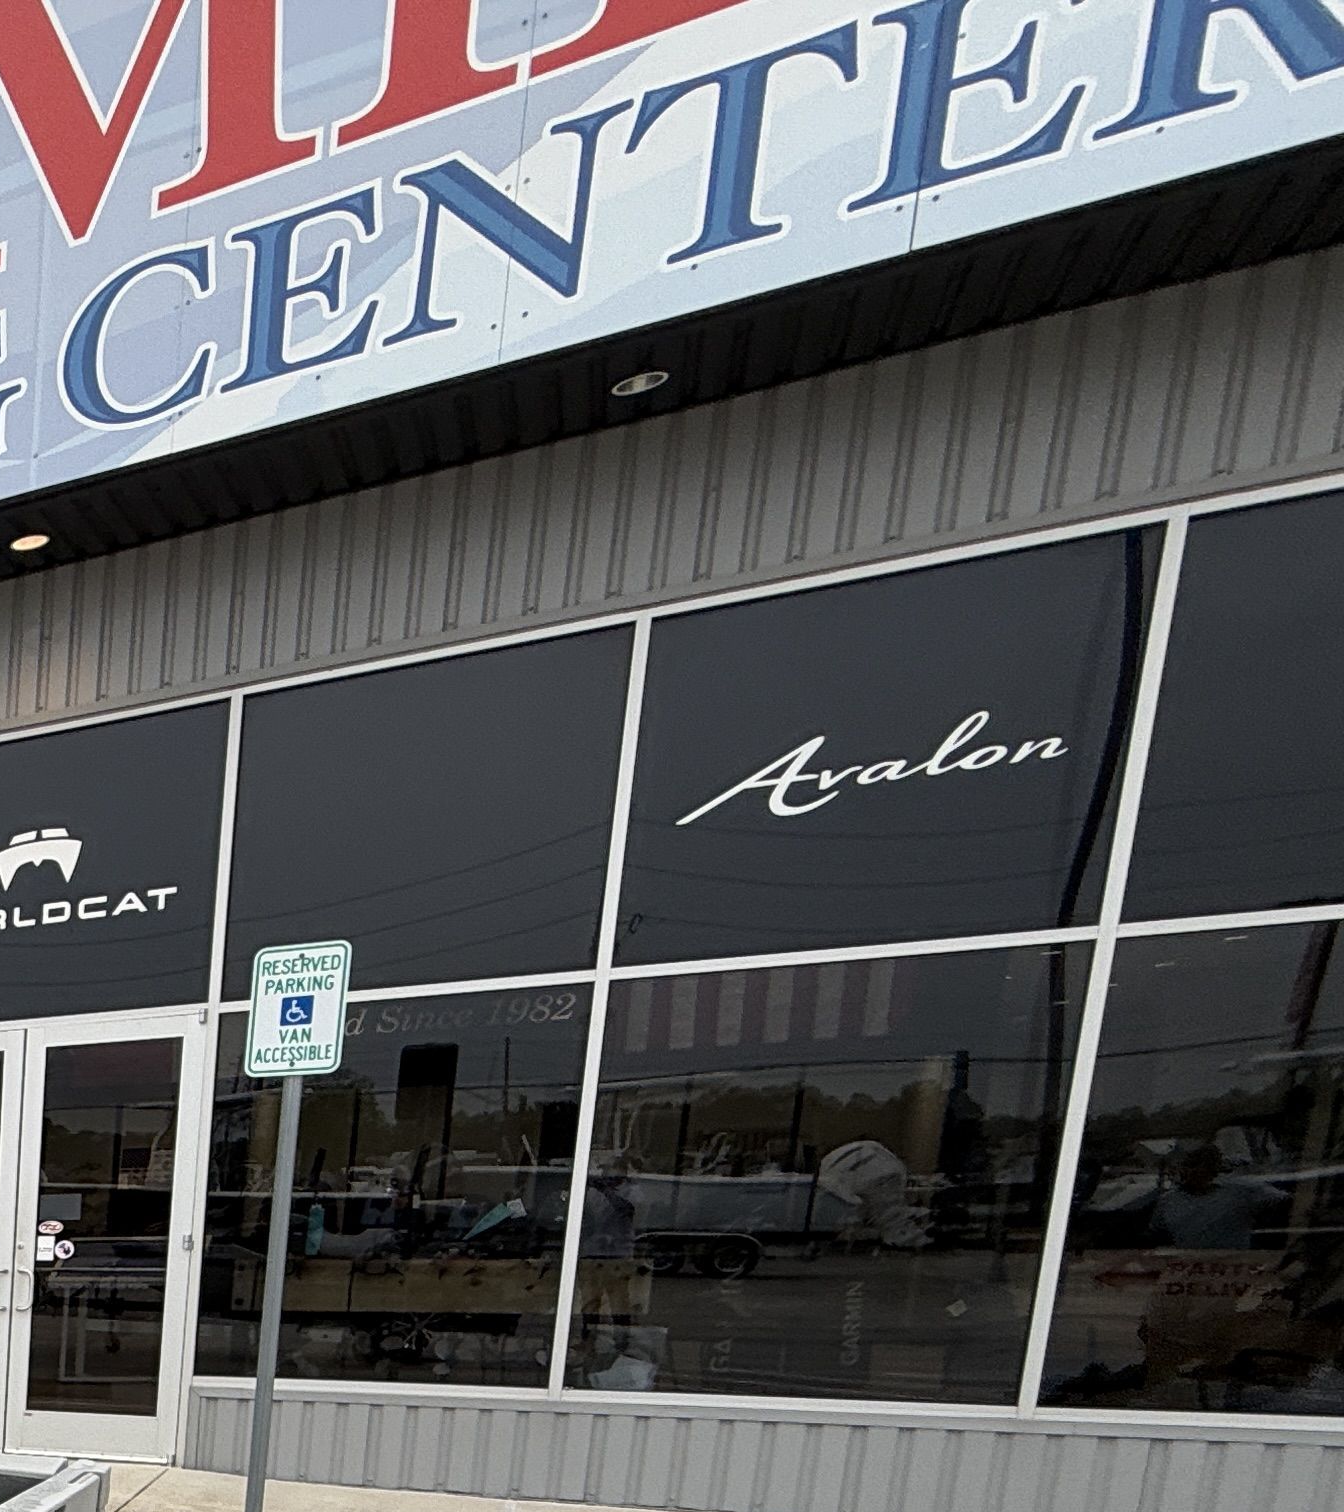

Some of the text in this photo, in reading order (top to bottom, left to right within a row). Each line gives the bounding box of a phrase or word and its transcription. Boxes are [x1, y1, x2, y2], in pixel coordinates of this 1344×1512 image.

[676, 710, 1069, 826] Avalon
[262, 954, 341, 976] RESERVED
[265, 975, 335, 995] PARKING
[279, 1028, 311, 1044] VAN
[254, 1044, 333, 1064] ACCESSIBLE
[840, 1281, 866, 1366] GARMIN
